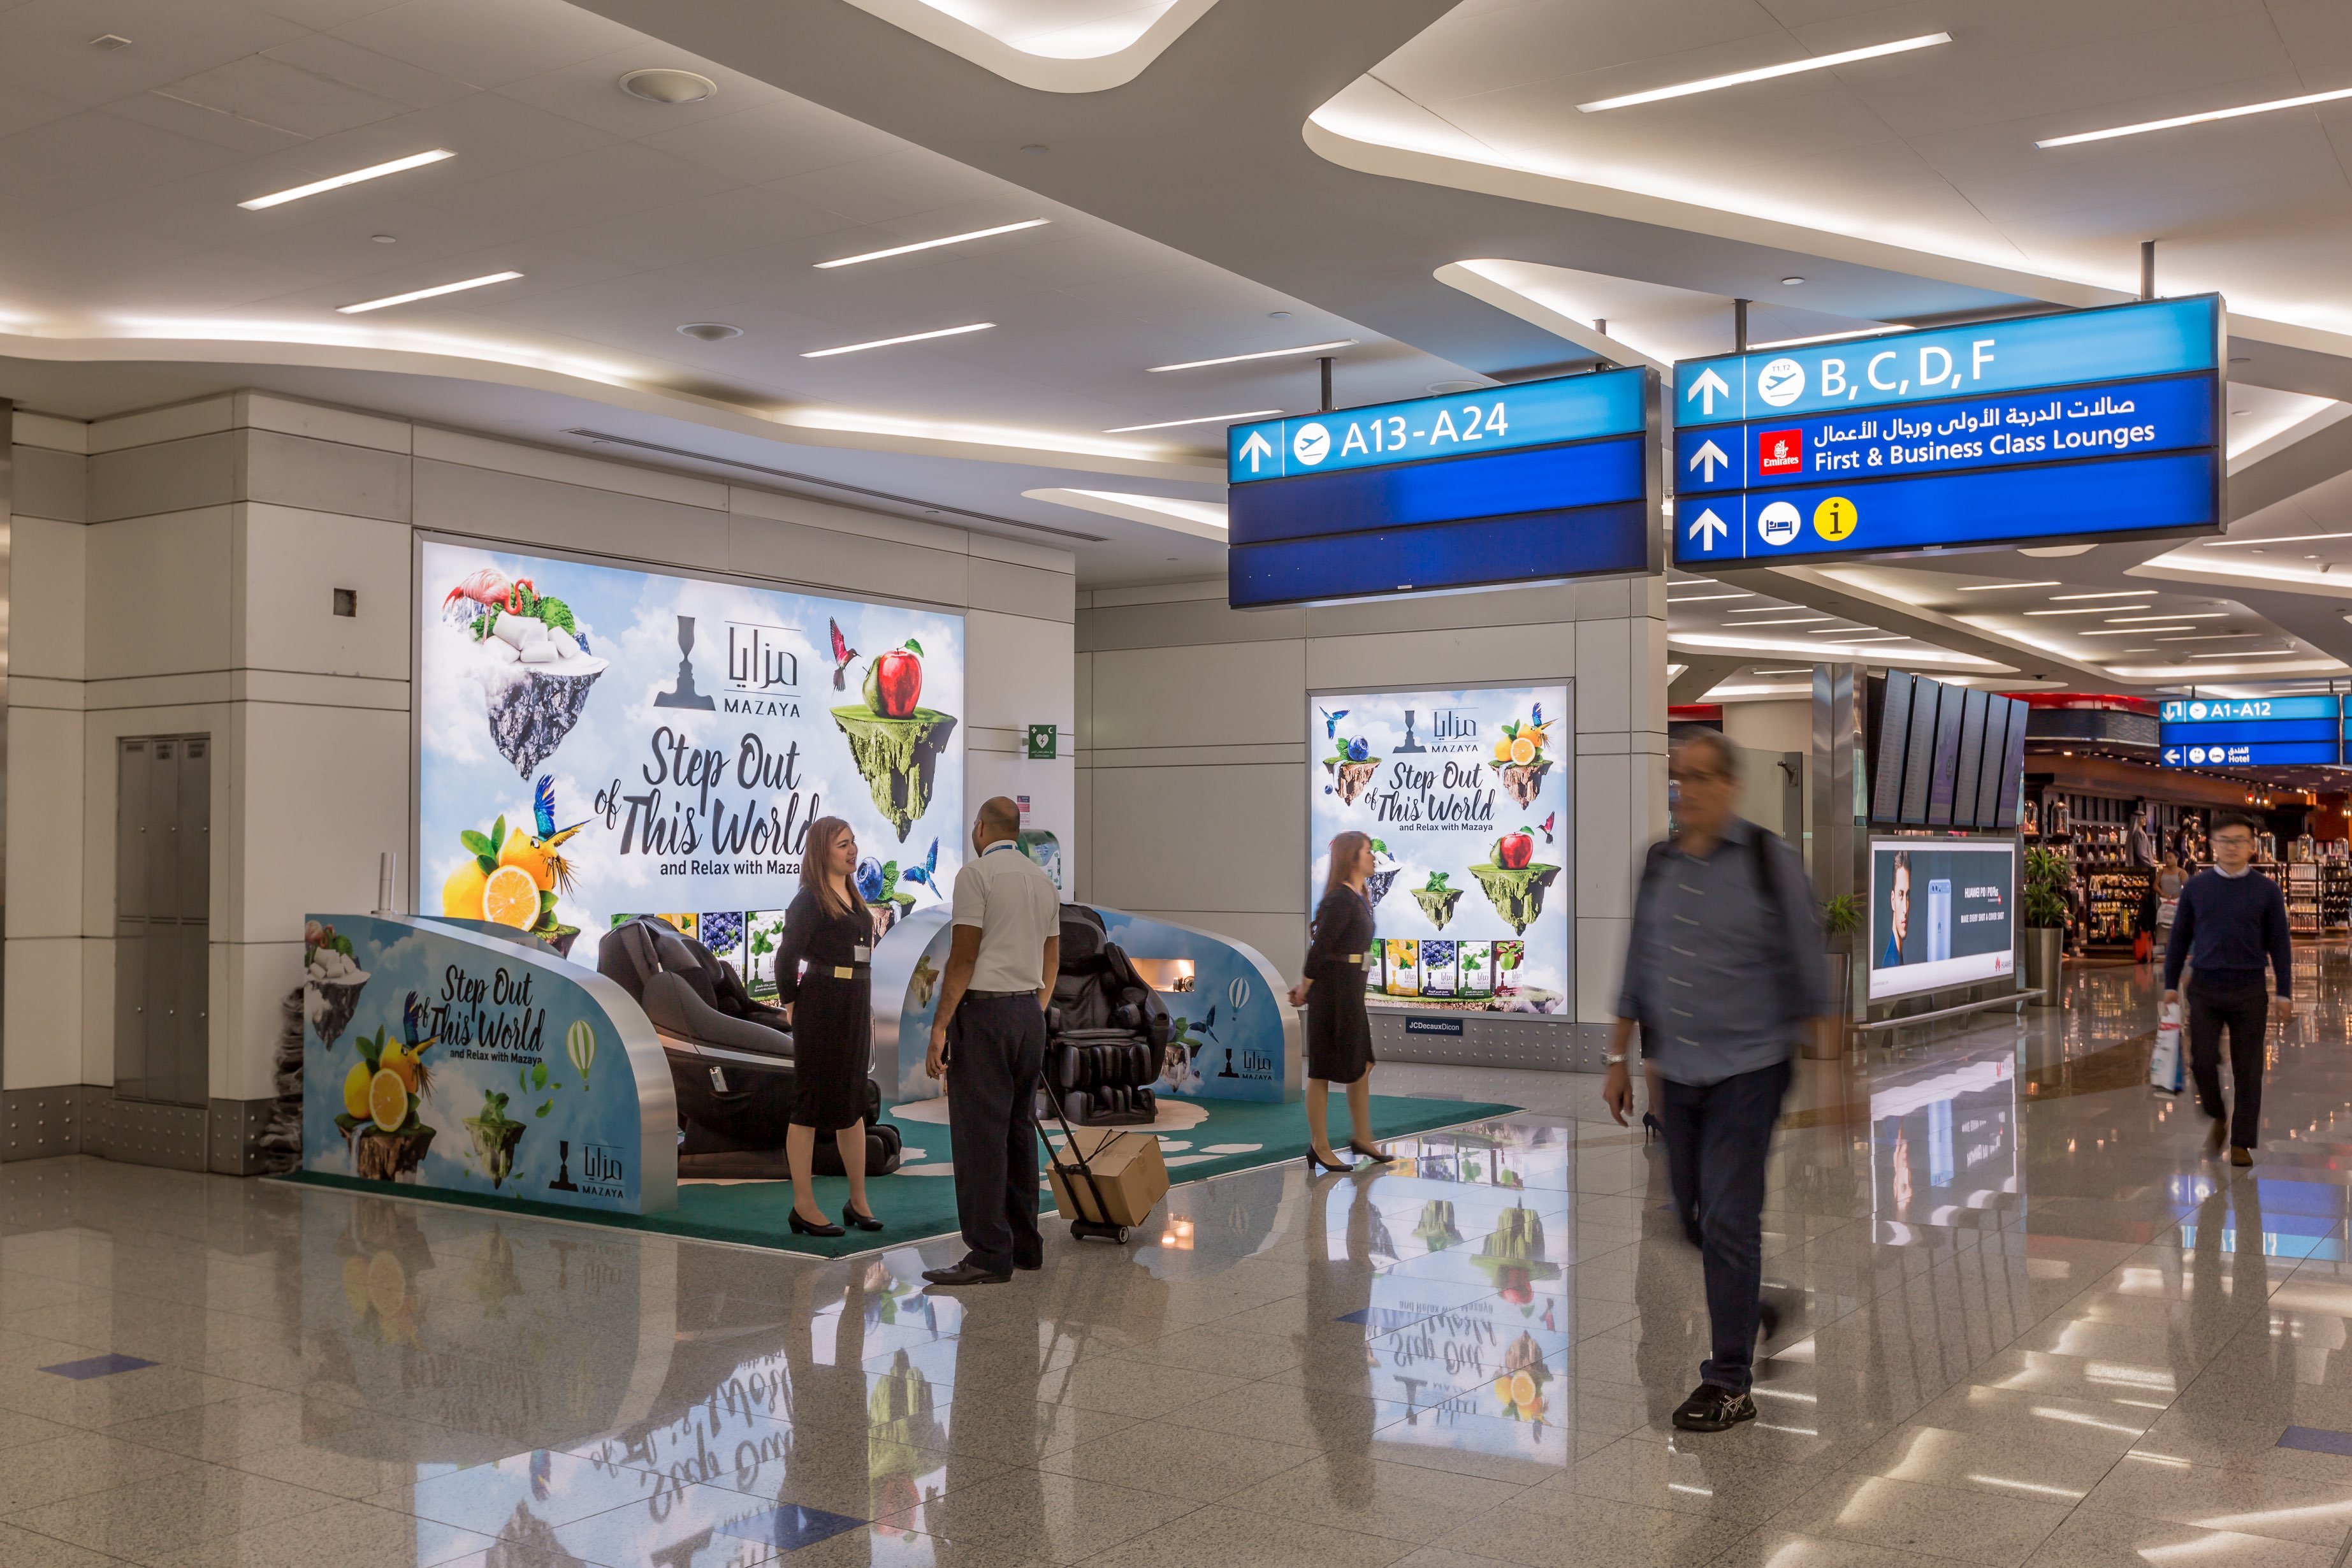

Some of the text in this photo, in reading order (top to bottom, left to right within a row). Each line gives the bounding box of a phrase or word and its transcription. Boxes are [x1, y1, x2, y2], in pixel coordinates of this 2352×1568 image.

[1340, 402, 1509, 457] A13-A24
[1813, 396, 2135, 447] صالات الدرجة الأولى ورجال الأعمال
[1815, 425, 2155, 471] First & Business Class Lounges
[1763, 456, 1799, 467] Emirates
[729, 627, 797, 689] مزايا
[724, 698, 801, 718] MAZAYA
[2210, 702, 2271, 718] A1-A12
[1434, 711, 1477, 740] مزايا
[1431, 744, 1479, 753] MAZAYA
[2228, 754, 2250, 764] Hotel
[642, 725, 801, 817] Step Out
[1389, 760, 1483, 804] Step Out
[1365, 787, 1496, 822] of This World
[594, 778, 820, 856] of This World
[1416, 823, 1439, 831] Relax
[1441, 823, 1459, 831] with
[1461, 823, 1493, 832] Mazaya
[660, 860, 802, 875] and Relax with Maza
[1964, 887, 1980, 898] HUAWEI
[1961, 914, 1969, 924] MAKE
[1970, 913, 1978, 922] EVERY
[1988, 911, 1997, 921] COVER
[2001, 960, 2012, 968] HUAWEI
[441, 964, 533, 1022] Step Out
[417, 996, 545, 1052] of This World
[1409, 1022, 1460, 1031] JCDecauxDicon
[450, 1049, 542, 1066] and Relax with Mazaya
[1244, 1050, 1271, 1071] مزايا
[585, 1145, 622, 1182] مزايا
[582, 1185, 623, 1199] MAZAYA
